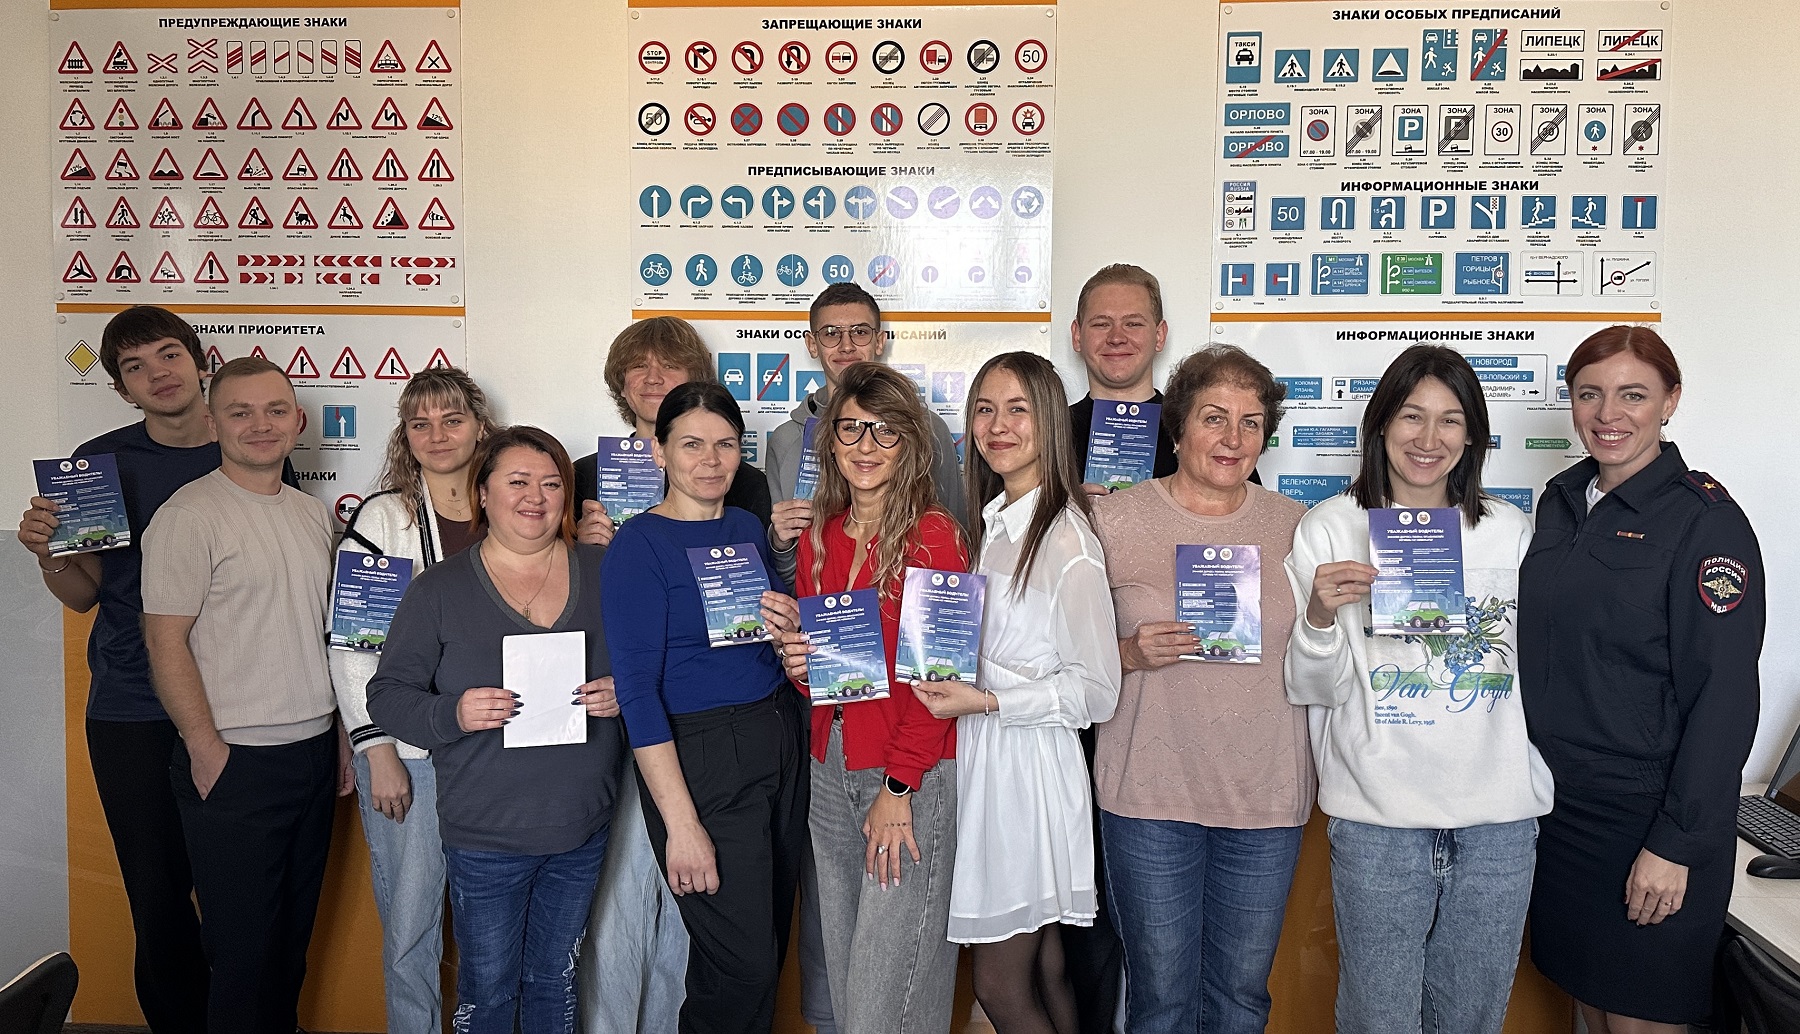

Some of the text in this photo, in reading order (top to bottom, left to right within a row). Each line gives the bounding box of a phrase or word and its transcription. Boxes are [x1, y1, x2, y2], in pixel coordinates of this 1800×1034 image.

[1332, 7, 1561, 20] ЗНАКИ ОСОБЫХ ПРЕДПИСАНИЙ
[158, 17, 347, 30] ПРЕДУПРЕЖДАЮЩИЕ ЗНАКИ
[761, 18, 922, 32] ЗАПРЕЩАЮЩИЕ ЗНАКИ
[1525, 35, 1581, 49] ЛИПЕЦК
[1602, 35, 1659, 48] ЛИПЕЦК
[1022, 50, 1040, 63] 50
[1229, 108, 1285, 120] ОРЛОВО
[1495, 127, 1508, 137] 30
[1228, 141, 1284, 152] ОРЛОВО
[747, 166, 935, 178] ПРЕДПИСЫВАЮЩИЕ ЗНАКИ
[1341, 180, 1539, 192] ИНФОРМАЦИОННЫЕ ЗНАКИ
[1277, 206, 1299, 221] 50
[1429, 199, 1447, 226] P
[829, 264, 849, 278] 50
[193, 324, 325, 336] ЗНАКИ ПРИОРИТЕТА
[736, 329, 780, 339] ЗНАКИ
[884, 328, 947, 340] ПИСАНИЙ
[1336, 330, 1535, 342] ИНФОРМАЦИОННЫЕ ЗНАКИ
[294, 471, 337, 482] ЗНАКИ
[1704, 557, 1746, 576] ПОЛИЦИЯ
[1705, 566, 1742, 583] РОССИЯ
[1710, 601, 1727, 613] МВД
[1370, 663, 1513, 713] Van Gogh
